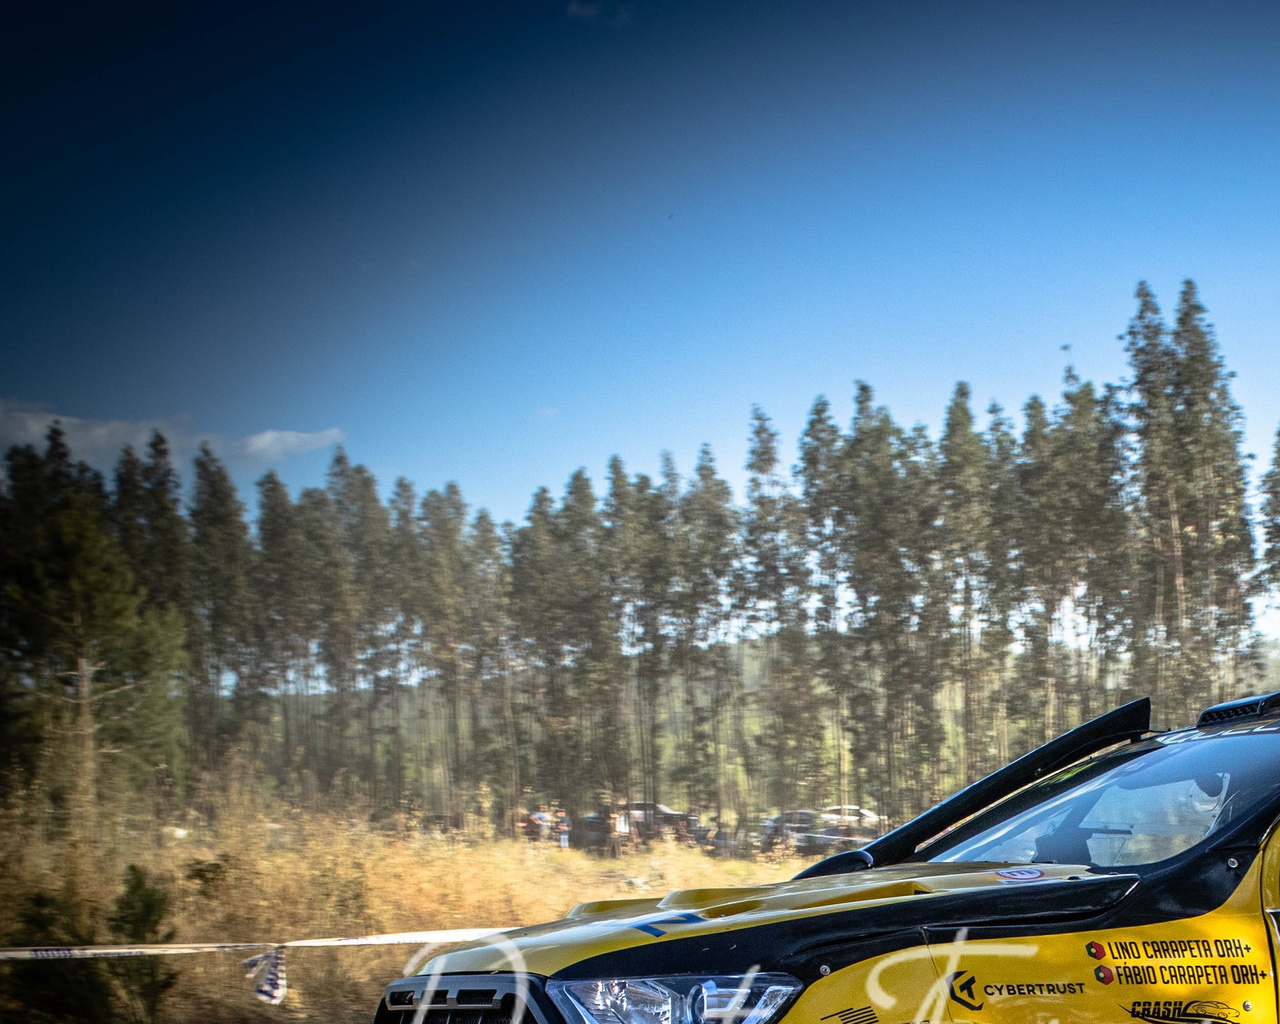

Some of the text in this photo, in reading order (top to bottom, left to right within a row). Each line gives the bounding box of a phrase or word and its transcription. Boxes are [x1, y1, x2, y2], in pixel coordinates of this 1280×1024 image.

[1107, 939, 1252, 960] LINO CARAPETA ORH+
[1116, 962, 1267, 986] FÁBIO CARAPETA ORH+
[983, 982, 1086, 997] CYBERTRUST
[1130, 1000, 1184, 1019] CRASH
